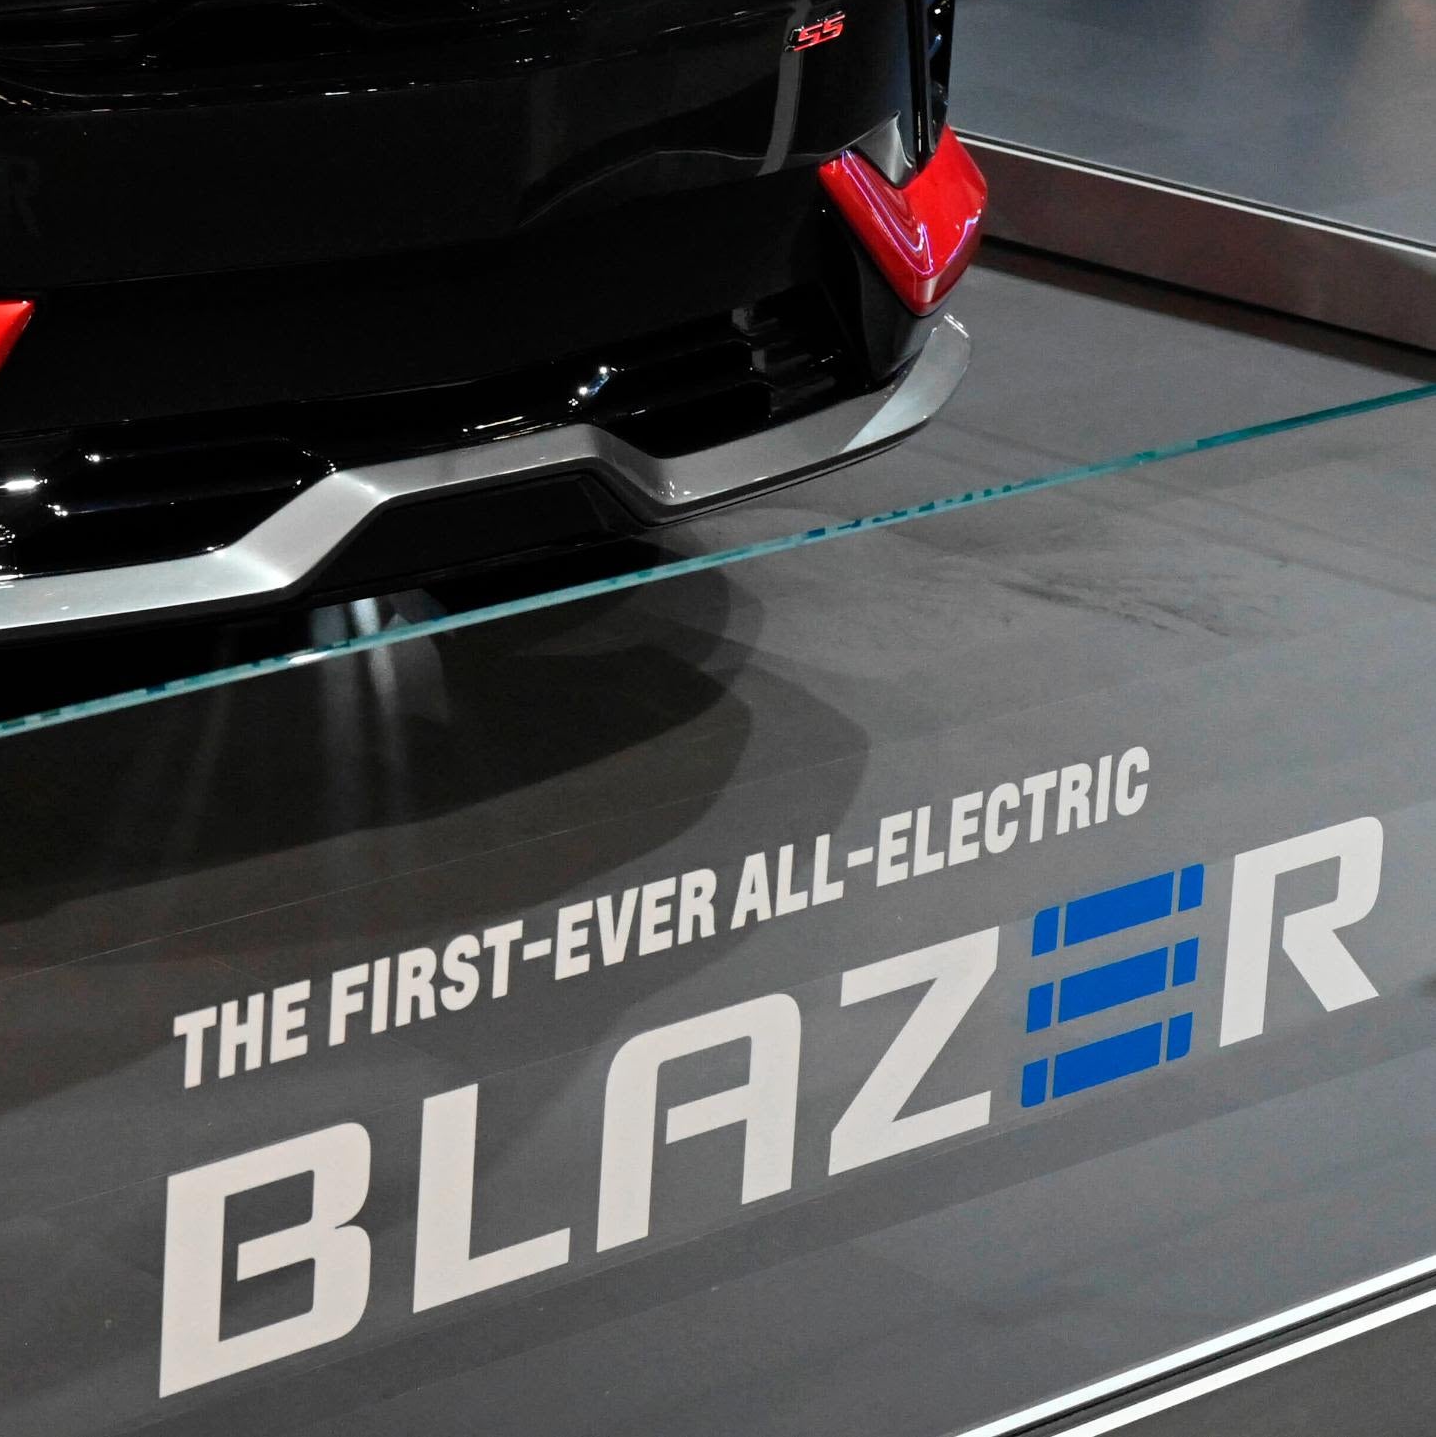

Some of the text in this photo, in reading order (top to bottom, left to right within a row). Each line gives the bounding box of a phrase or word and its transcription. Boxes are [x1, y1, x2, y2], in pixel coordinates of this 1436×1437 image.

[789, 10, 847, 53] SS
[174, 746, 1150, 1089] THE FIRST-EVER ALL-ELECTRIC
[160, 816, 1384, 1398] BLAZER
